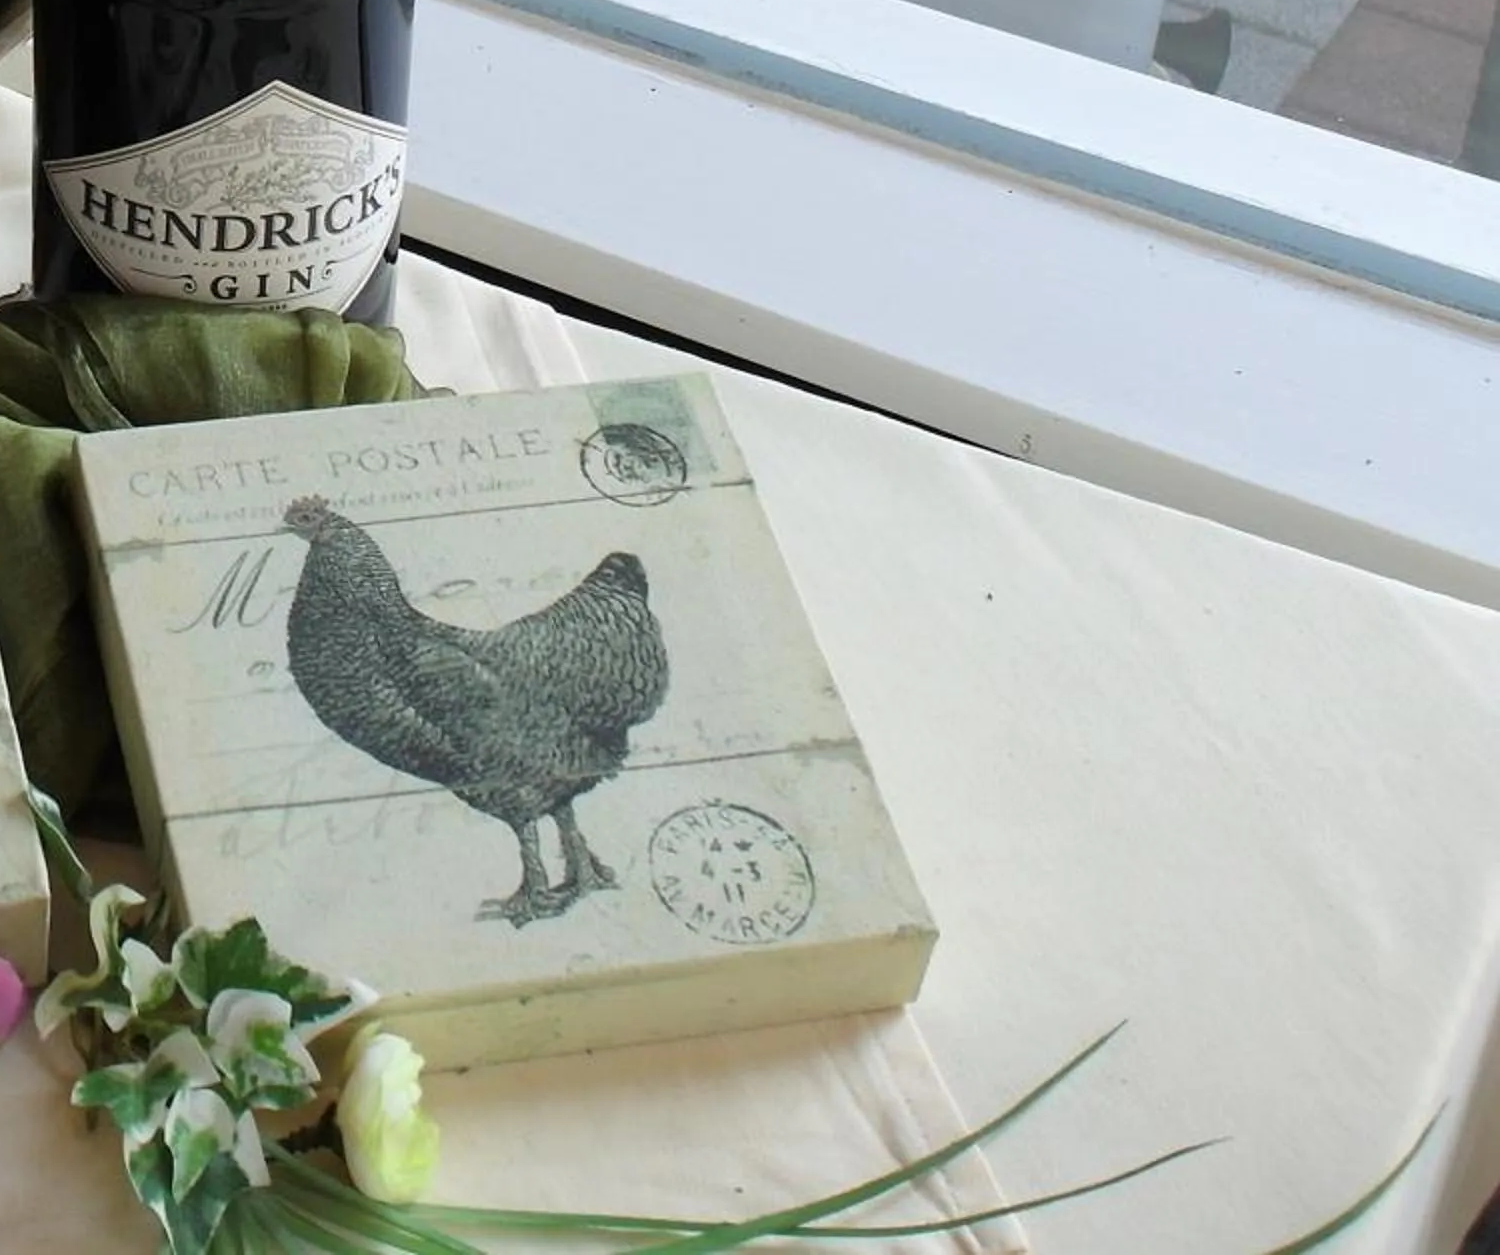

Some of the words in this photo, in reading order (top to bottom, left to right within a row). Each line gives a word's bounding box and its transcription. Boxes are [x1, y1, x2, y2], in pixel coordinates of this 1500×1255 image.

[82, 154, 400, 252] HENDRICK'S
[210, 265, 315, 300] GIN
[129, 458, 289, 500] CARTE
[328, 427, 552, 479] POSTALE
